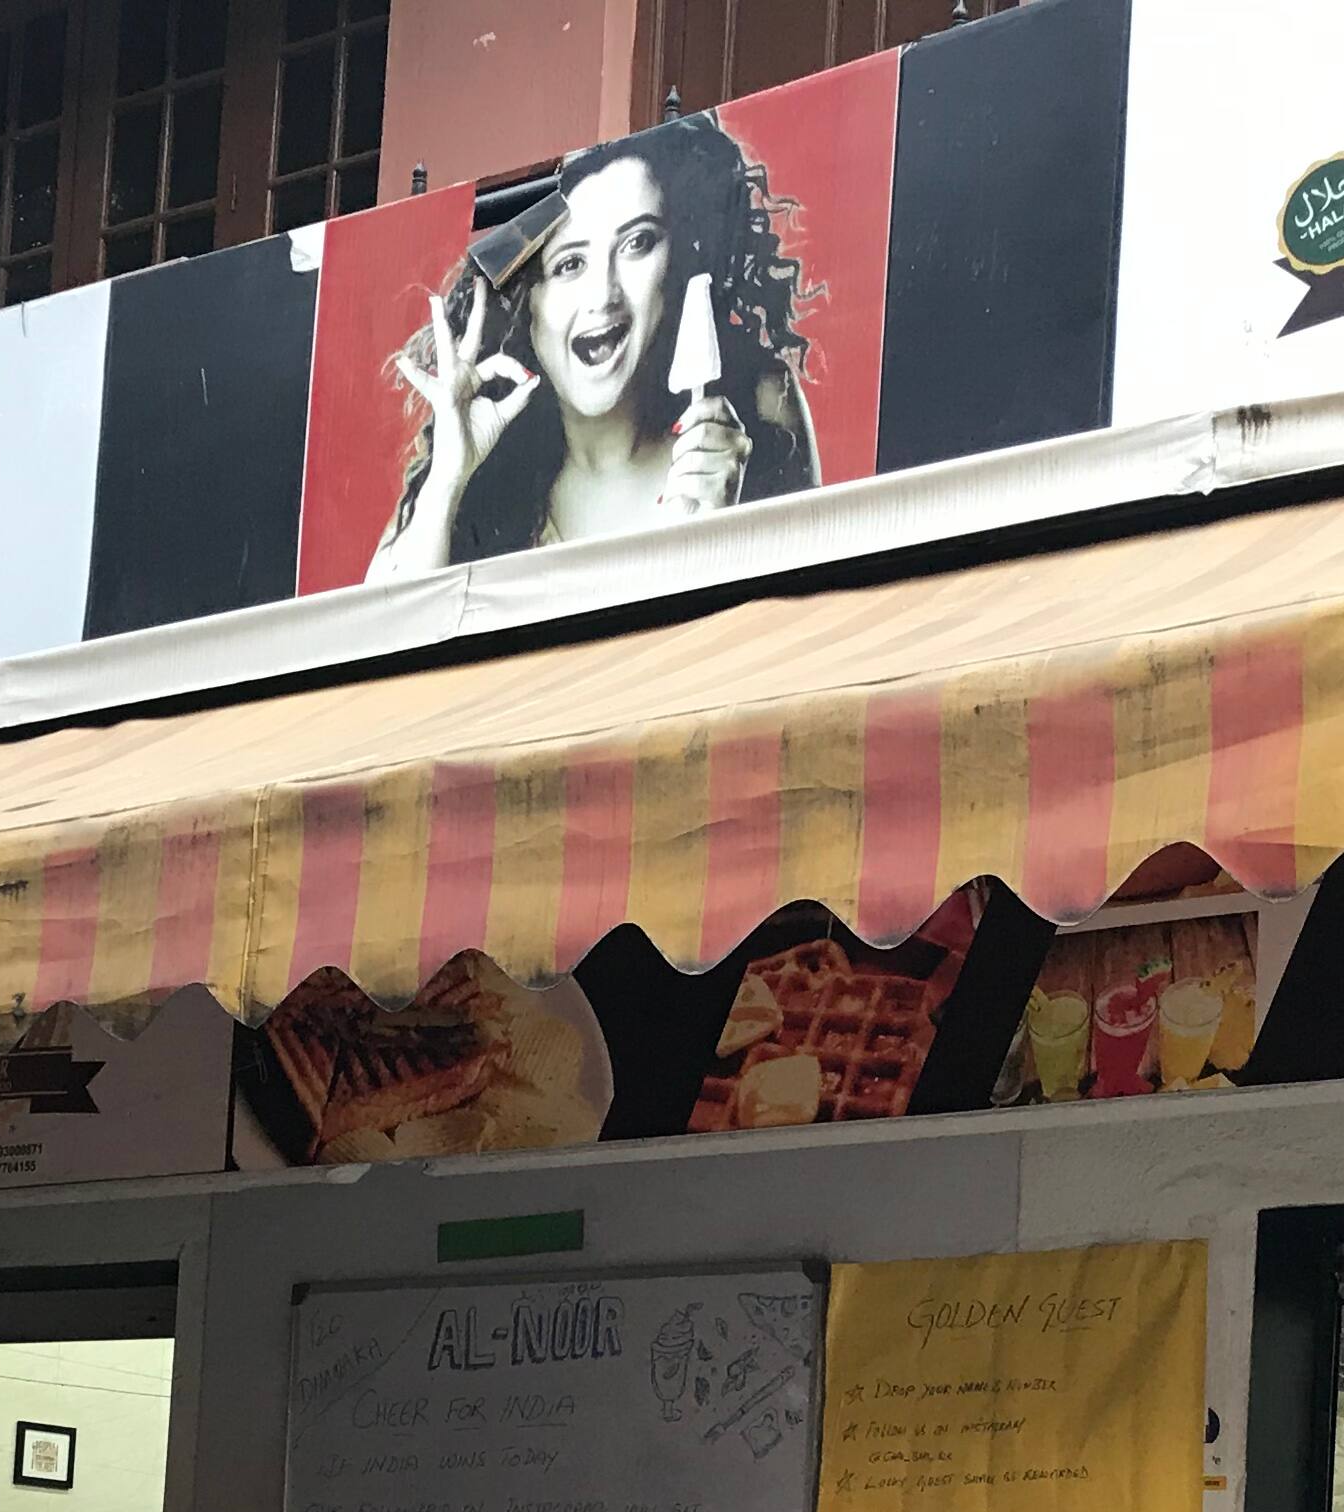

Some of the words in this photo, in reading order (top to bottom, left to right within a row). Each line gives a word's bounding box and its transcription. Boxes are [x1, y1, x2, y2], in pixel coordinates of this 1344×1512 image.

[427, 1295, 625, 1372] AL-NOOR
[907, 1295, 1031, 1349] GOLDEN
[443, 1397, 487, 1424] FOR
[499, 1395, 576, 1424] INDIA
[360, 1454, 419, 1474] INDIA
[439, 1450, 487, 1472] WINS
